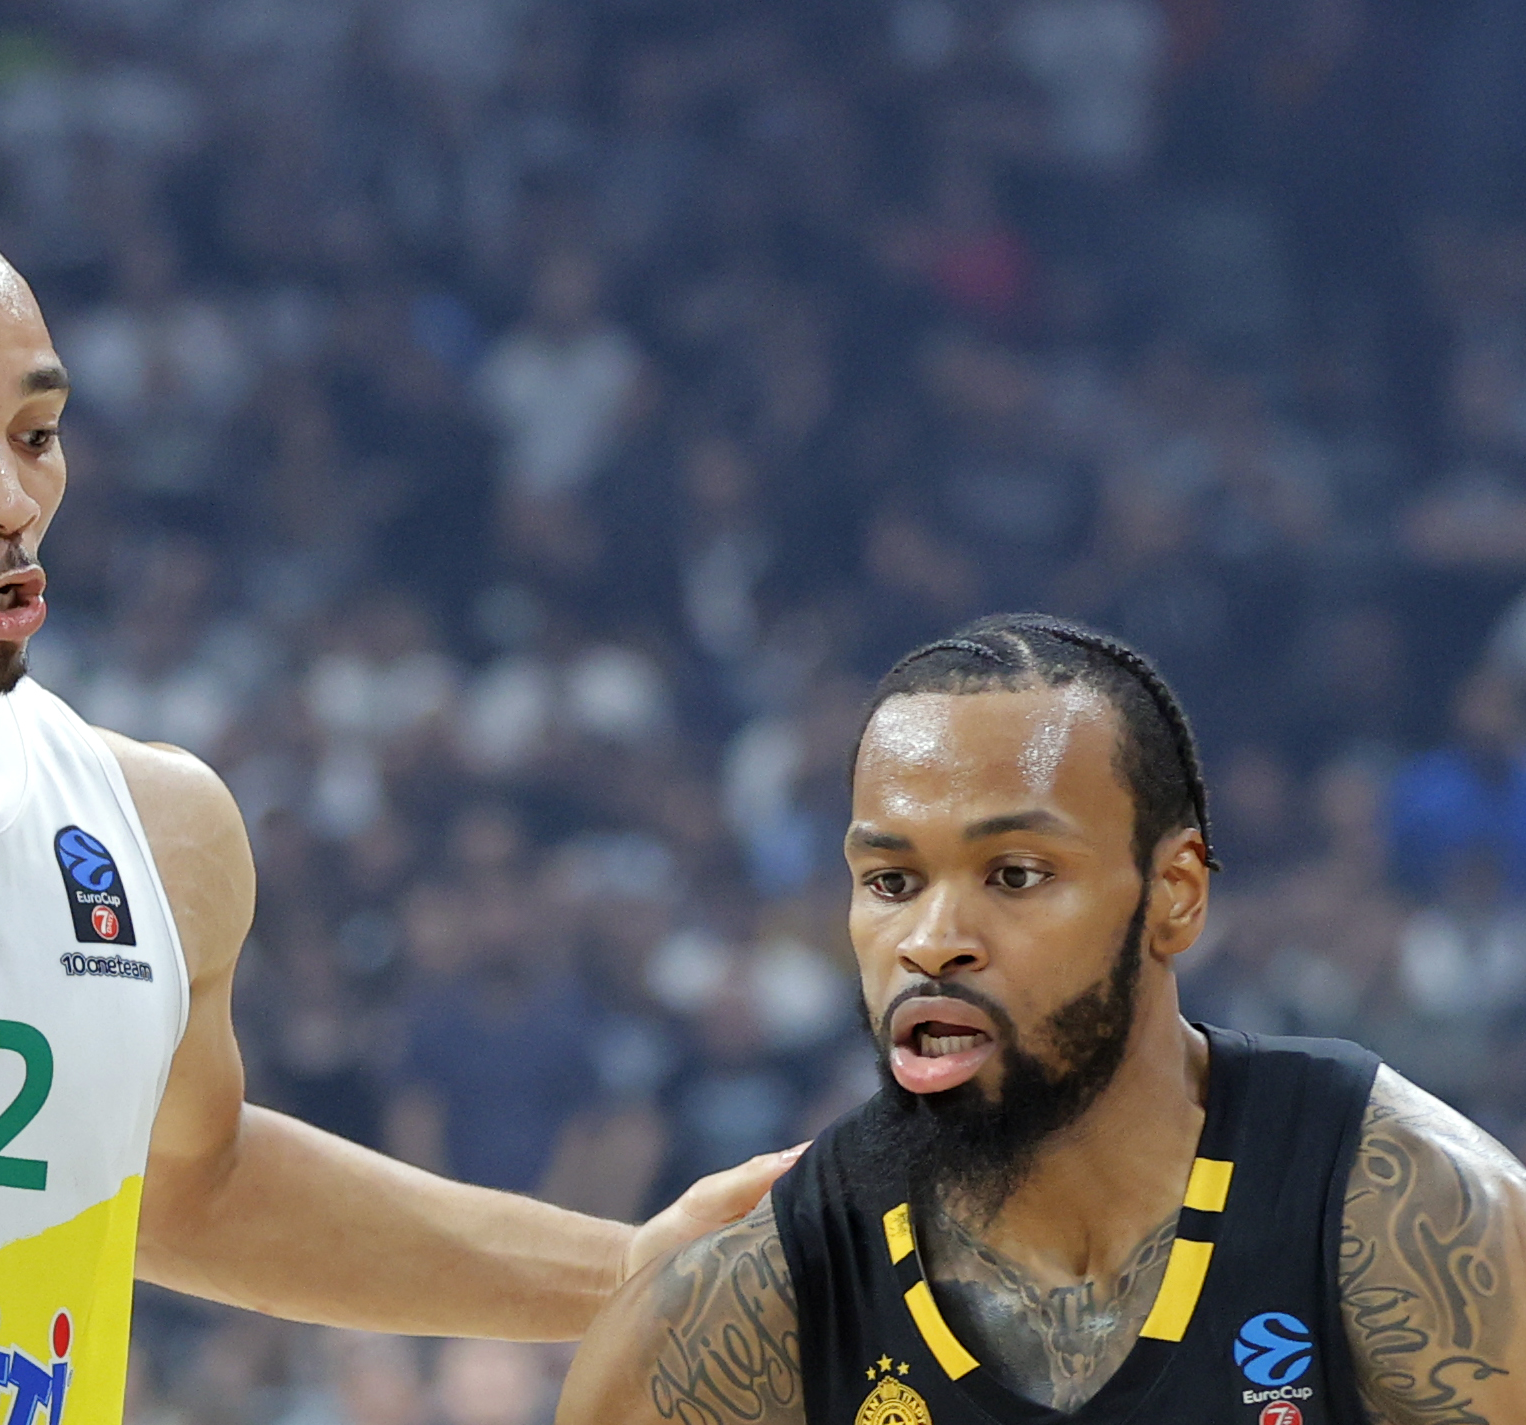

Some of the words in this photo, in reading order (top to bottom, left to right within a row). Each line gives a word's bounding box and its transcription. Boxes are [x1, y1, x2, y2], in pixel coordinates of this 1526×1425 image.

[76, 891, 121, 907] EuroCup
[95, 910, 109, 935] 7
[1242, 1385, 1313, 1404] EuroCup
